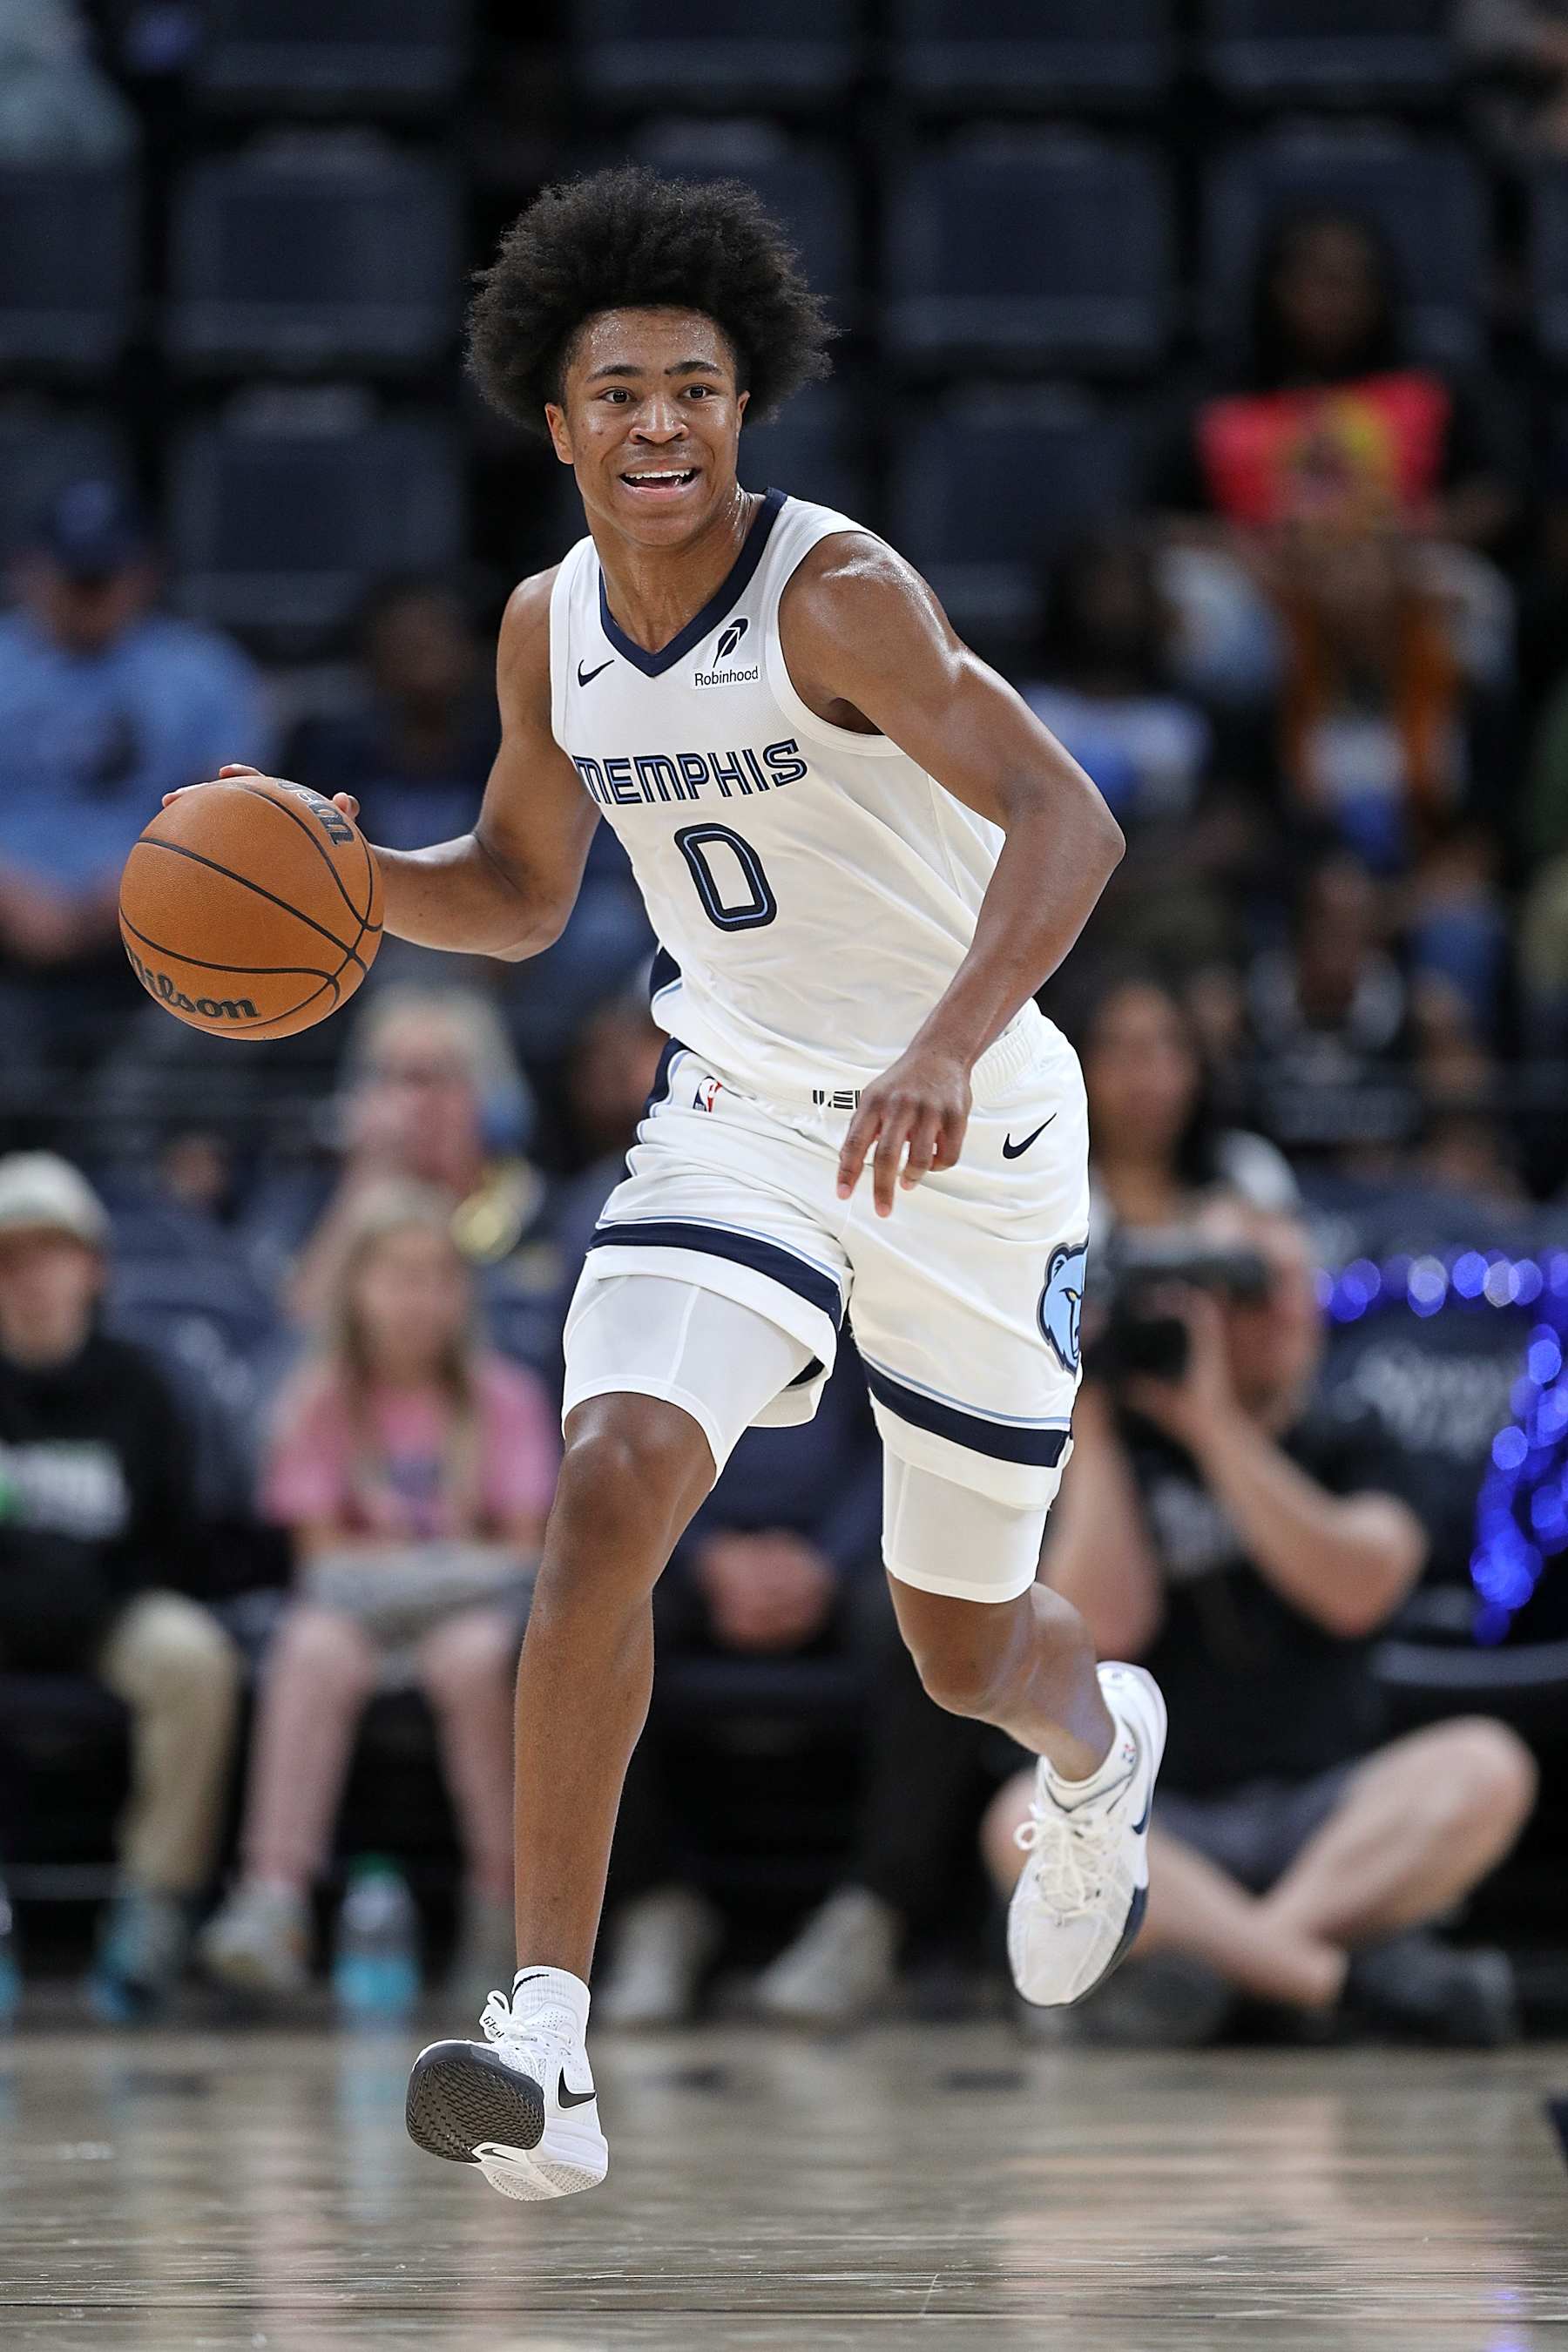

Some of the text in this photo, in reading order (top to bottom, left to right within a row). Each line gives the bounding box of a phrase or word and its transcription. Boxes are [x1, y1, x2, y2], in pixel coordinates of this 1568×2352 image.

[694, 665, 759, 686] Robinhood
[571, 738, 808, 805] MEMPHIS
[673, 822, 777, 932] 0
